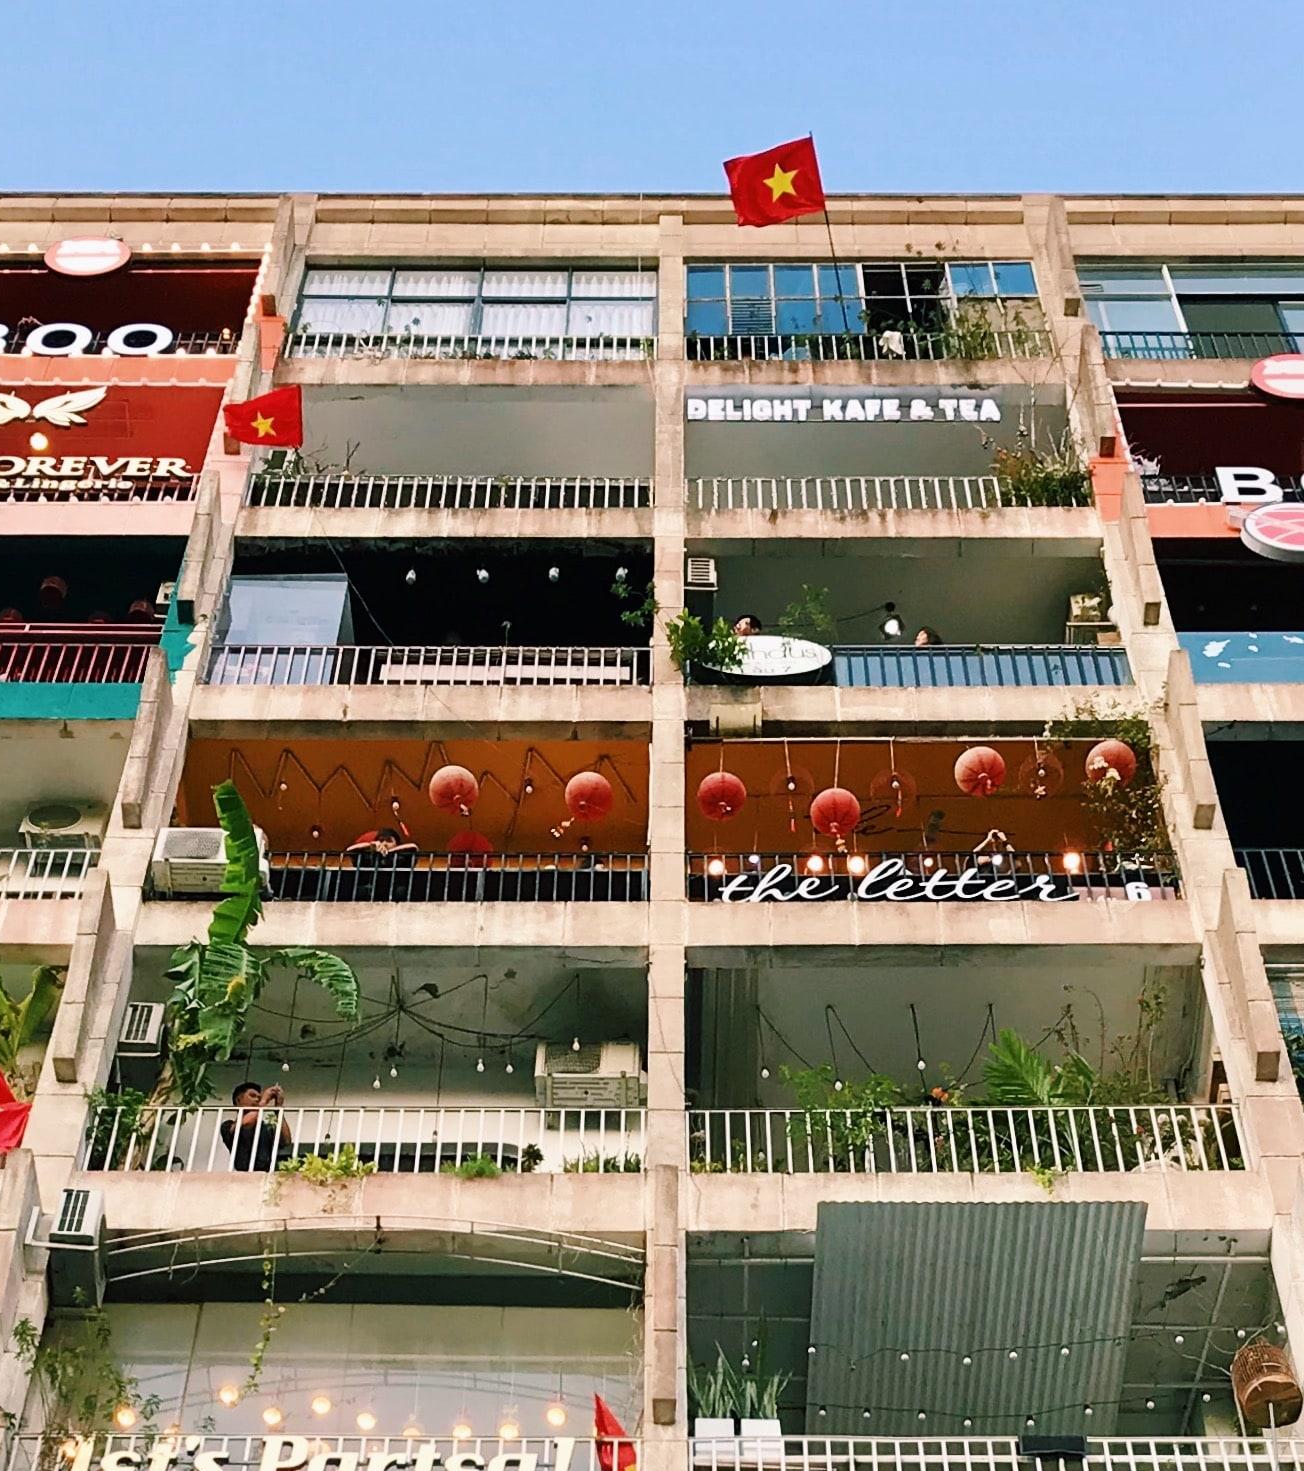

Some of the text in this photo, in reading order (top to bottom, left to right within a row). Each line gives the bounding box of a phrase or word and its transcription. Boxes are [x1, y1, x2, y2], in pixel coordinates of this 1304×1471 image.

[687, 398, 1002, 422] DELIGHT KAFE & TEA
[718, 863, 839, 903] the
[855, 857, 1080, 903] letter
